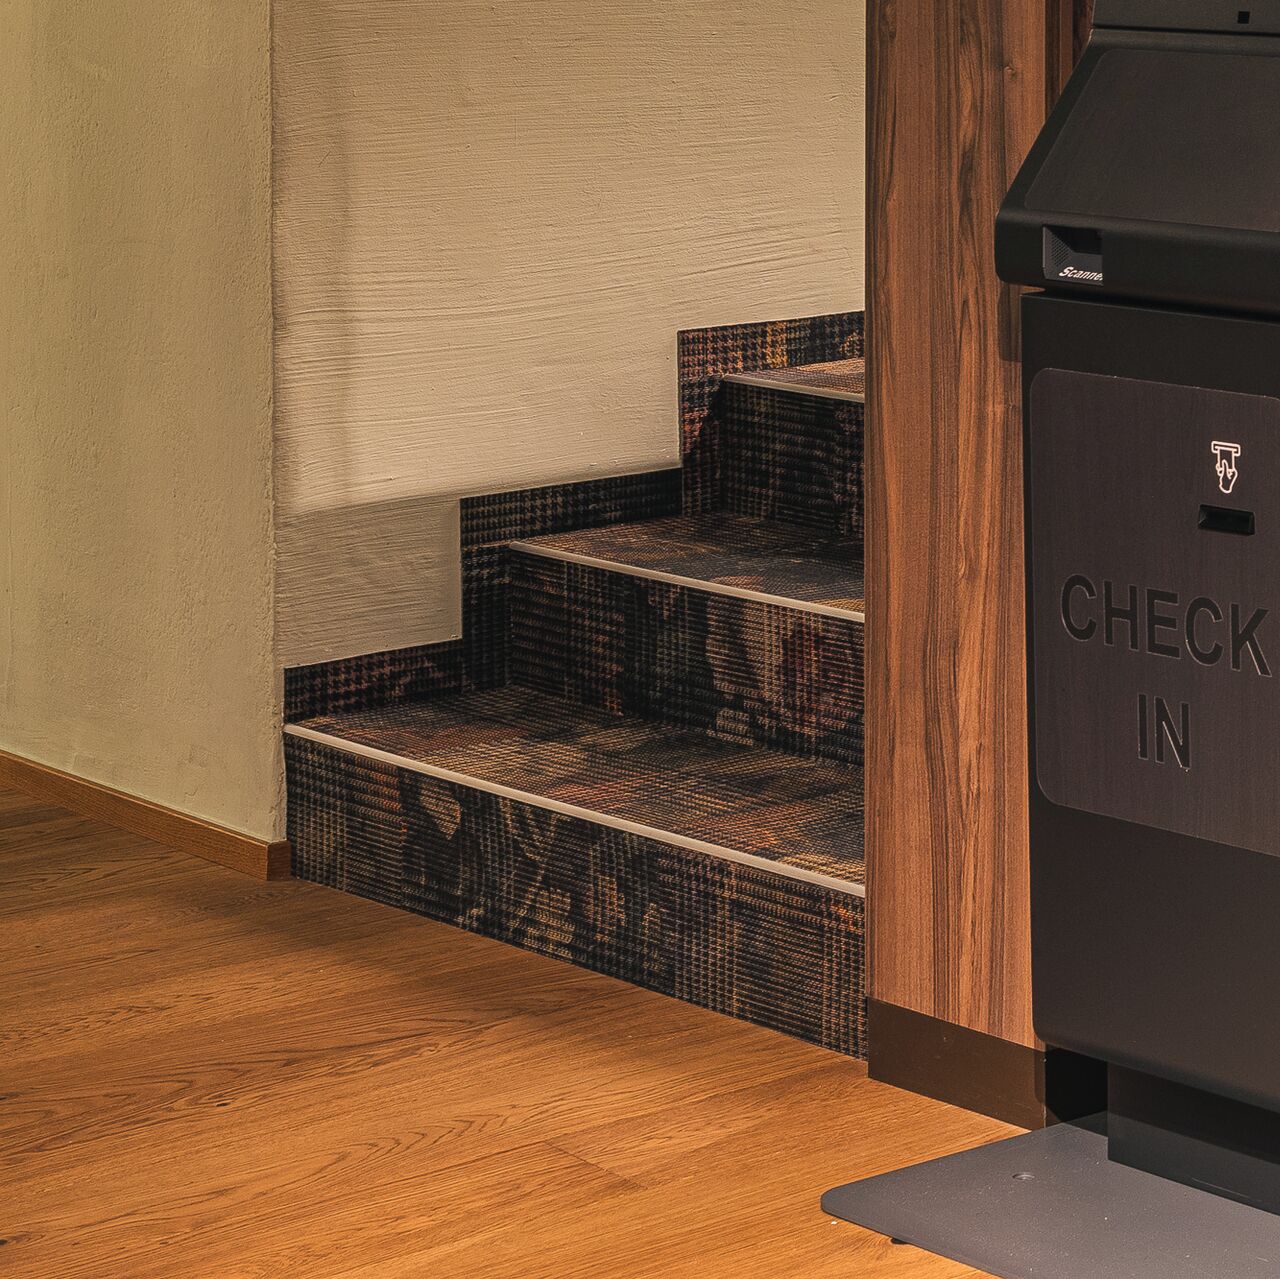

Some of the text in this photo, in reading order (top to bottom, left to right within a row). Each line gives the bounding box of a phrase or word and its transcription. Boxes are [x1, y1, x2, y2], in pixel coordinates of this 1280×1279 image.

[1059, 266, 1104, 281] Scanne
[1061, 573, 1272, 677] CHECK
[1137, 693, 1191, 770] IN
